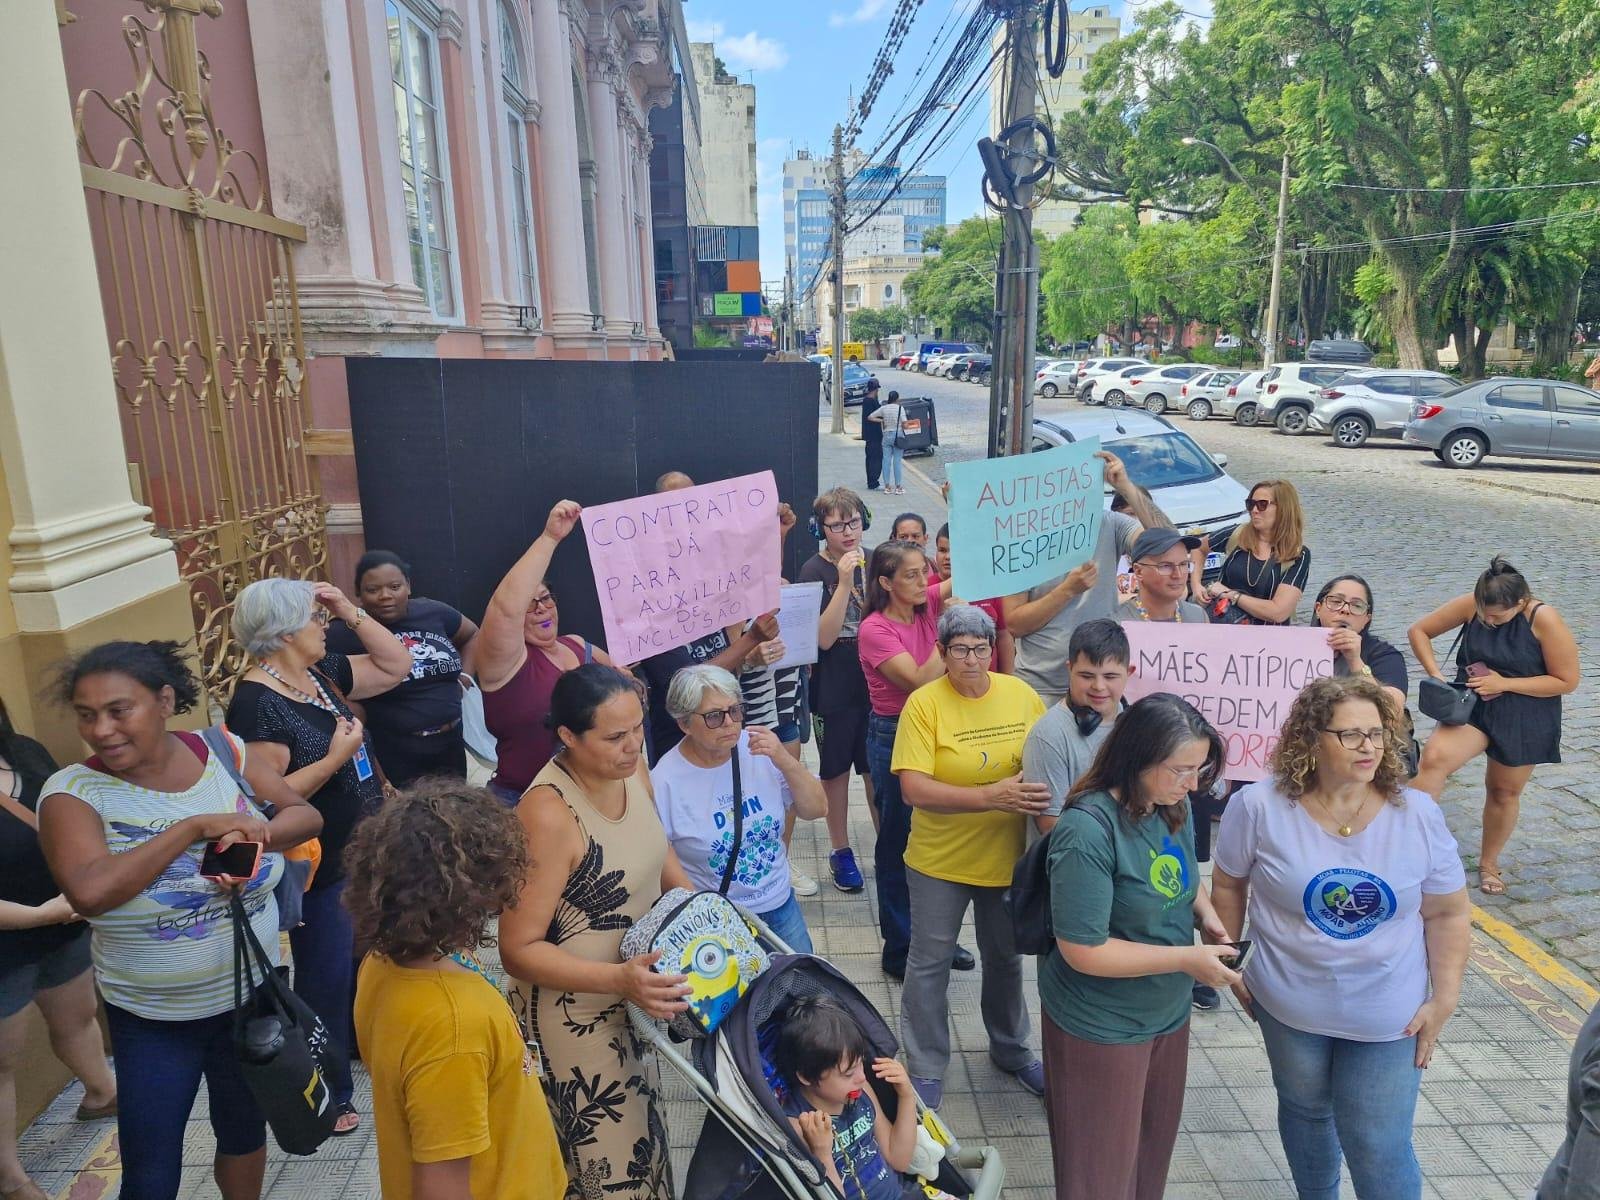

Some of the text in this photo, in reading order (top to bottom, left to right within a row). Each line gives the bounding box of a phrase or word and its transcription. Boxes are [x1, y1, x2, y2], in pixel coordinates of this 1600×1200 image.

[977, 462, 1093, 510] AUTISTAS
[591, 488, 765, 546] CONTRATO
[994, 496, 1086, 541] MERECEM
[668, 532, 701, 558] JÁ
[991, 513, 1095, 576] RESPEITO!
[606, 566, 681, 601] PARA
[676, 604, 701, 623] DE
[668, 907, 720, 951] MINIONS
[1319, 908, 1345, 928] MOAB
